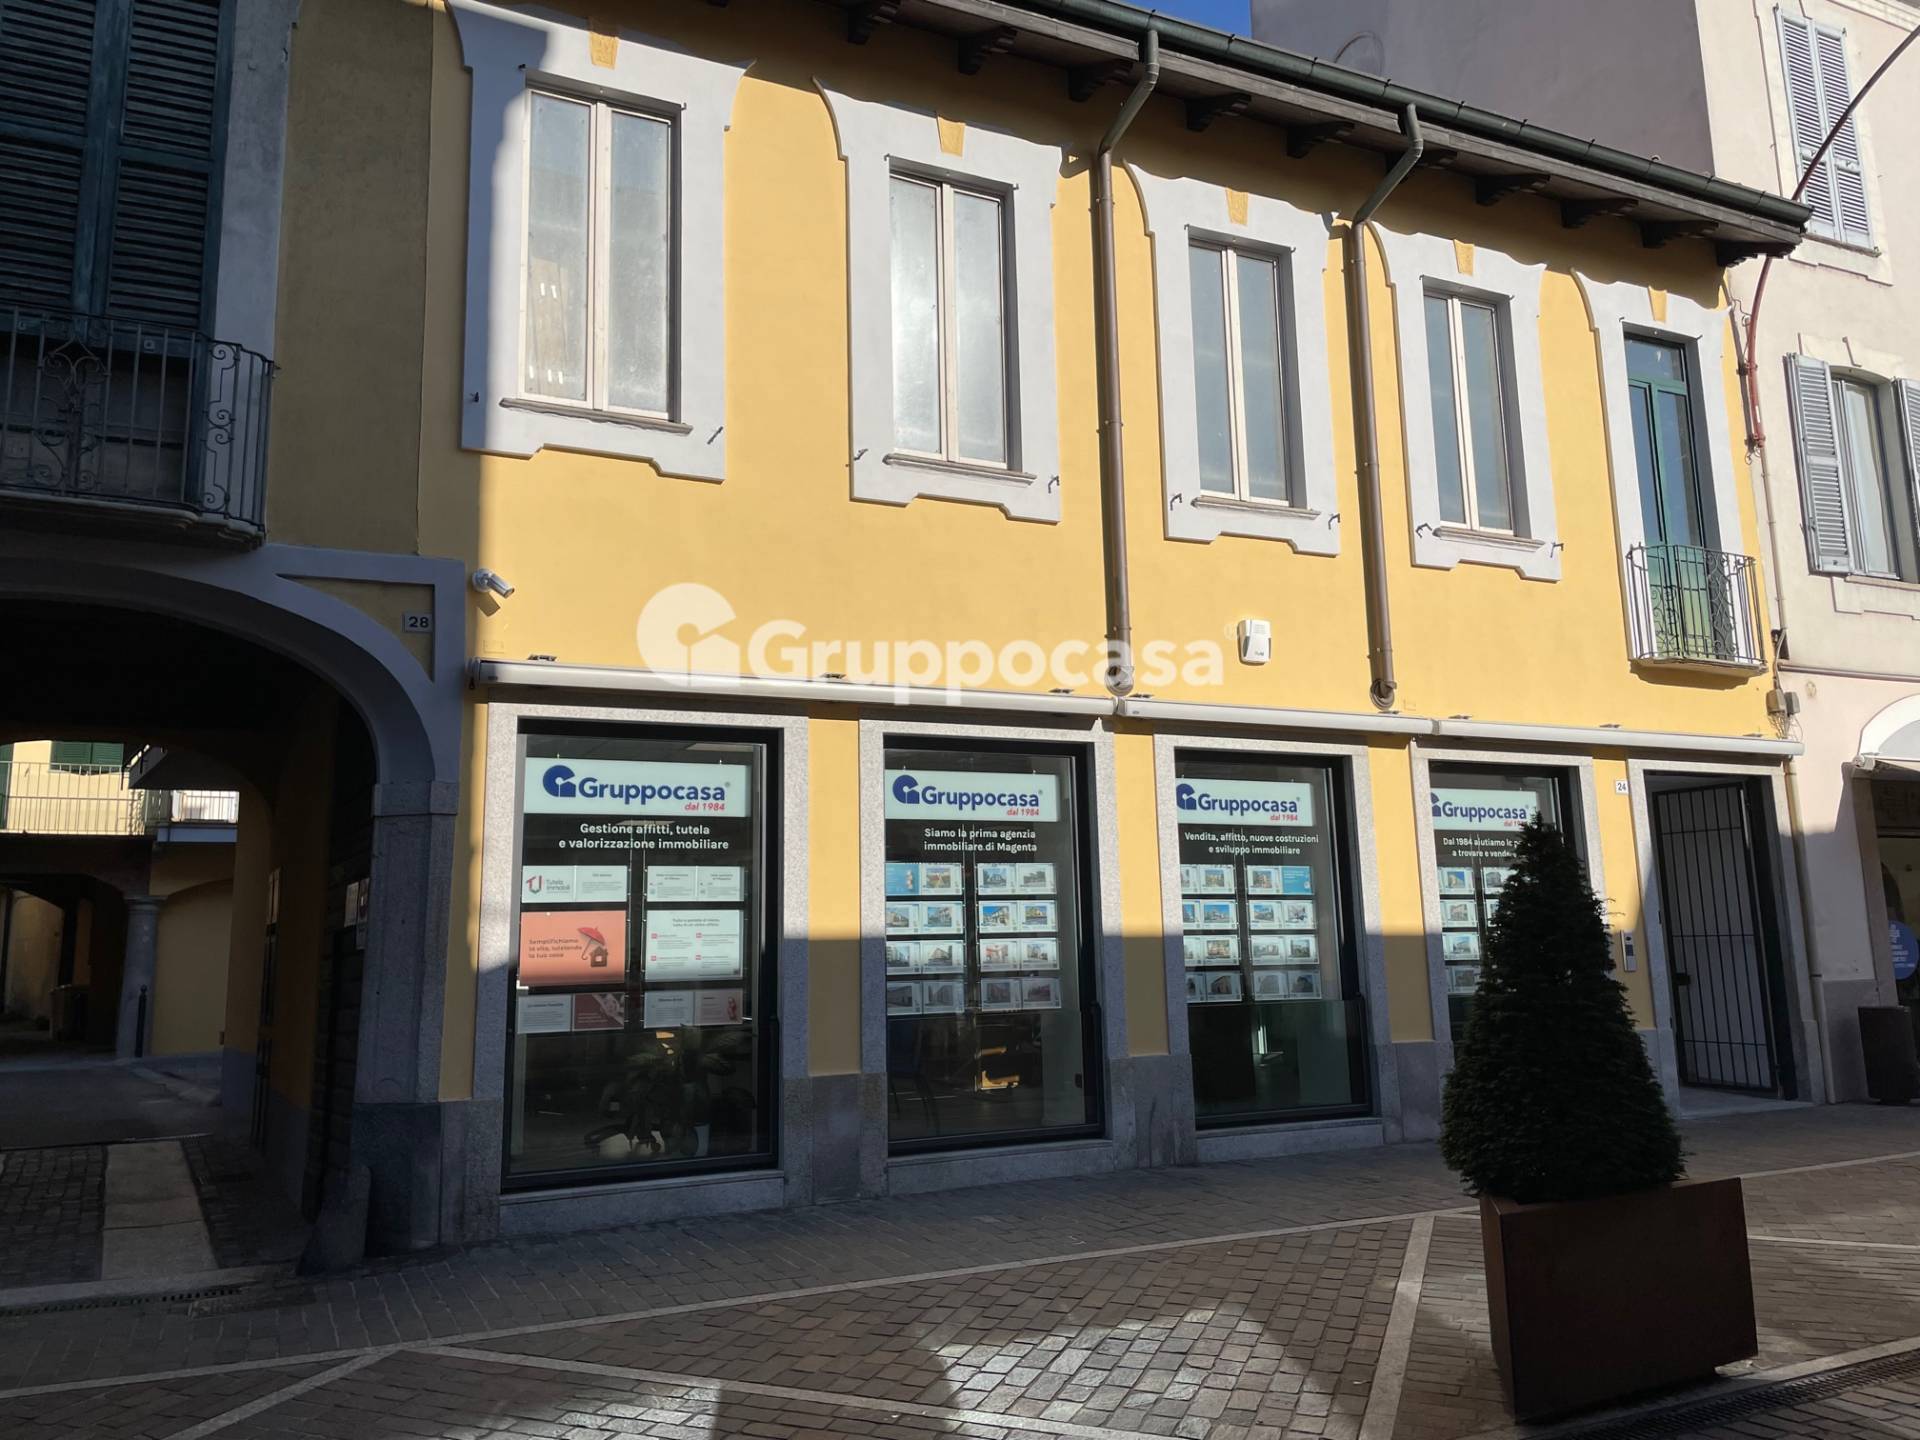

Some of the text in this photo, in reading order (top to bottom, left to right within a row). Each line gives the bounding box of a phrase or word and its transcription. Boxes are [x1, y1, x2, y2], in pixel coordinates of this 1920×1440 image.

[408, 616, 429, 628] 28
[578, 776, 726, 805] Gruppocasa
[1617, 781, 1627, 791] 24
[921, 786, 1040, 811] Gruppocasa
[1198, 793, 1298, 816] Gruppocasa
[684, 803, 725, 811] dal 1984
[1021, 808, 1040, 816] 1984
[1442, 801, 1527, 822] Gruppocasa
[580, 823, 710, 836] Gestione affitti, tutela
[924, 828, 1036, 841] Siamo la prima agenzia
[1185, 832, 1218, 842] Vendita,
[1220, 832, 1248, 842] affitto,
[1275, 834, 1318, 843] costruzioni
[559, 838, 729, 850] e valorizzazione immobiliare
[924, 841, 1037, 854] immobiliare di Magenta
[1215, 845, 1249, 856] sviluppo
[1252, 847, 1300, 855] immobiliare
